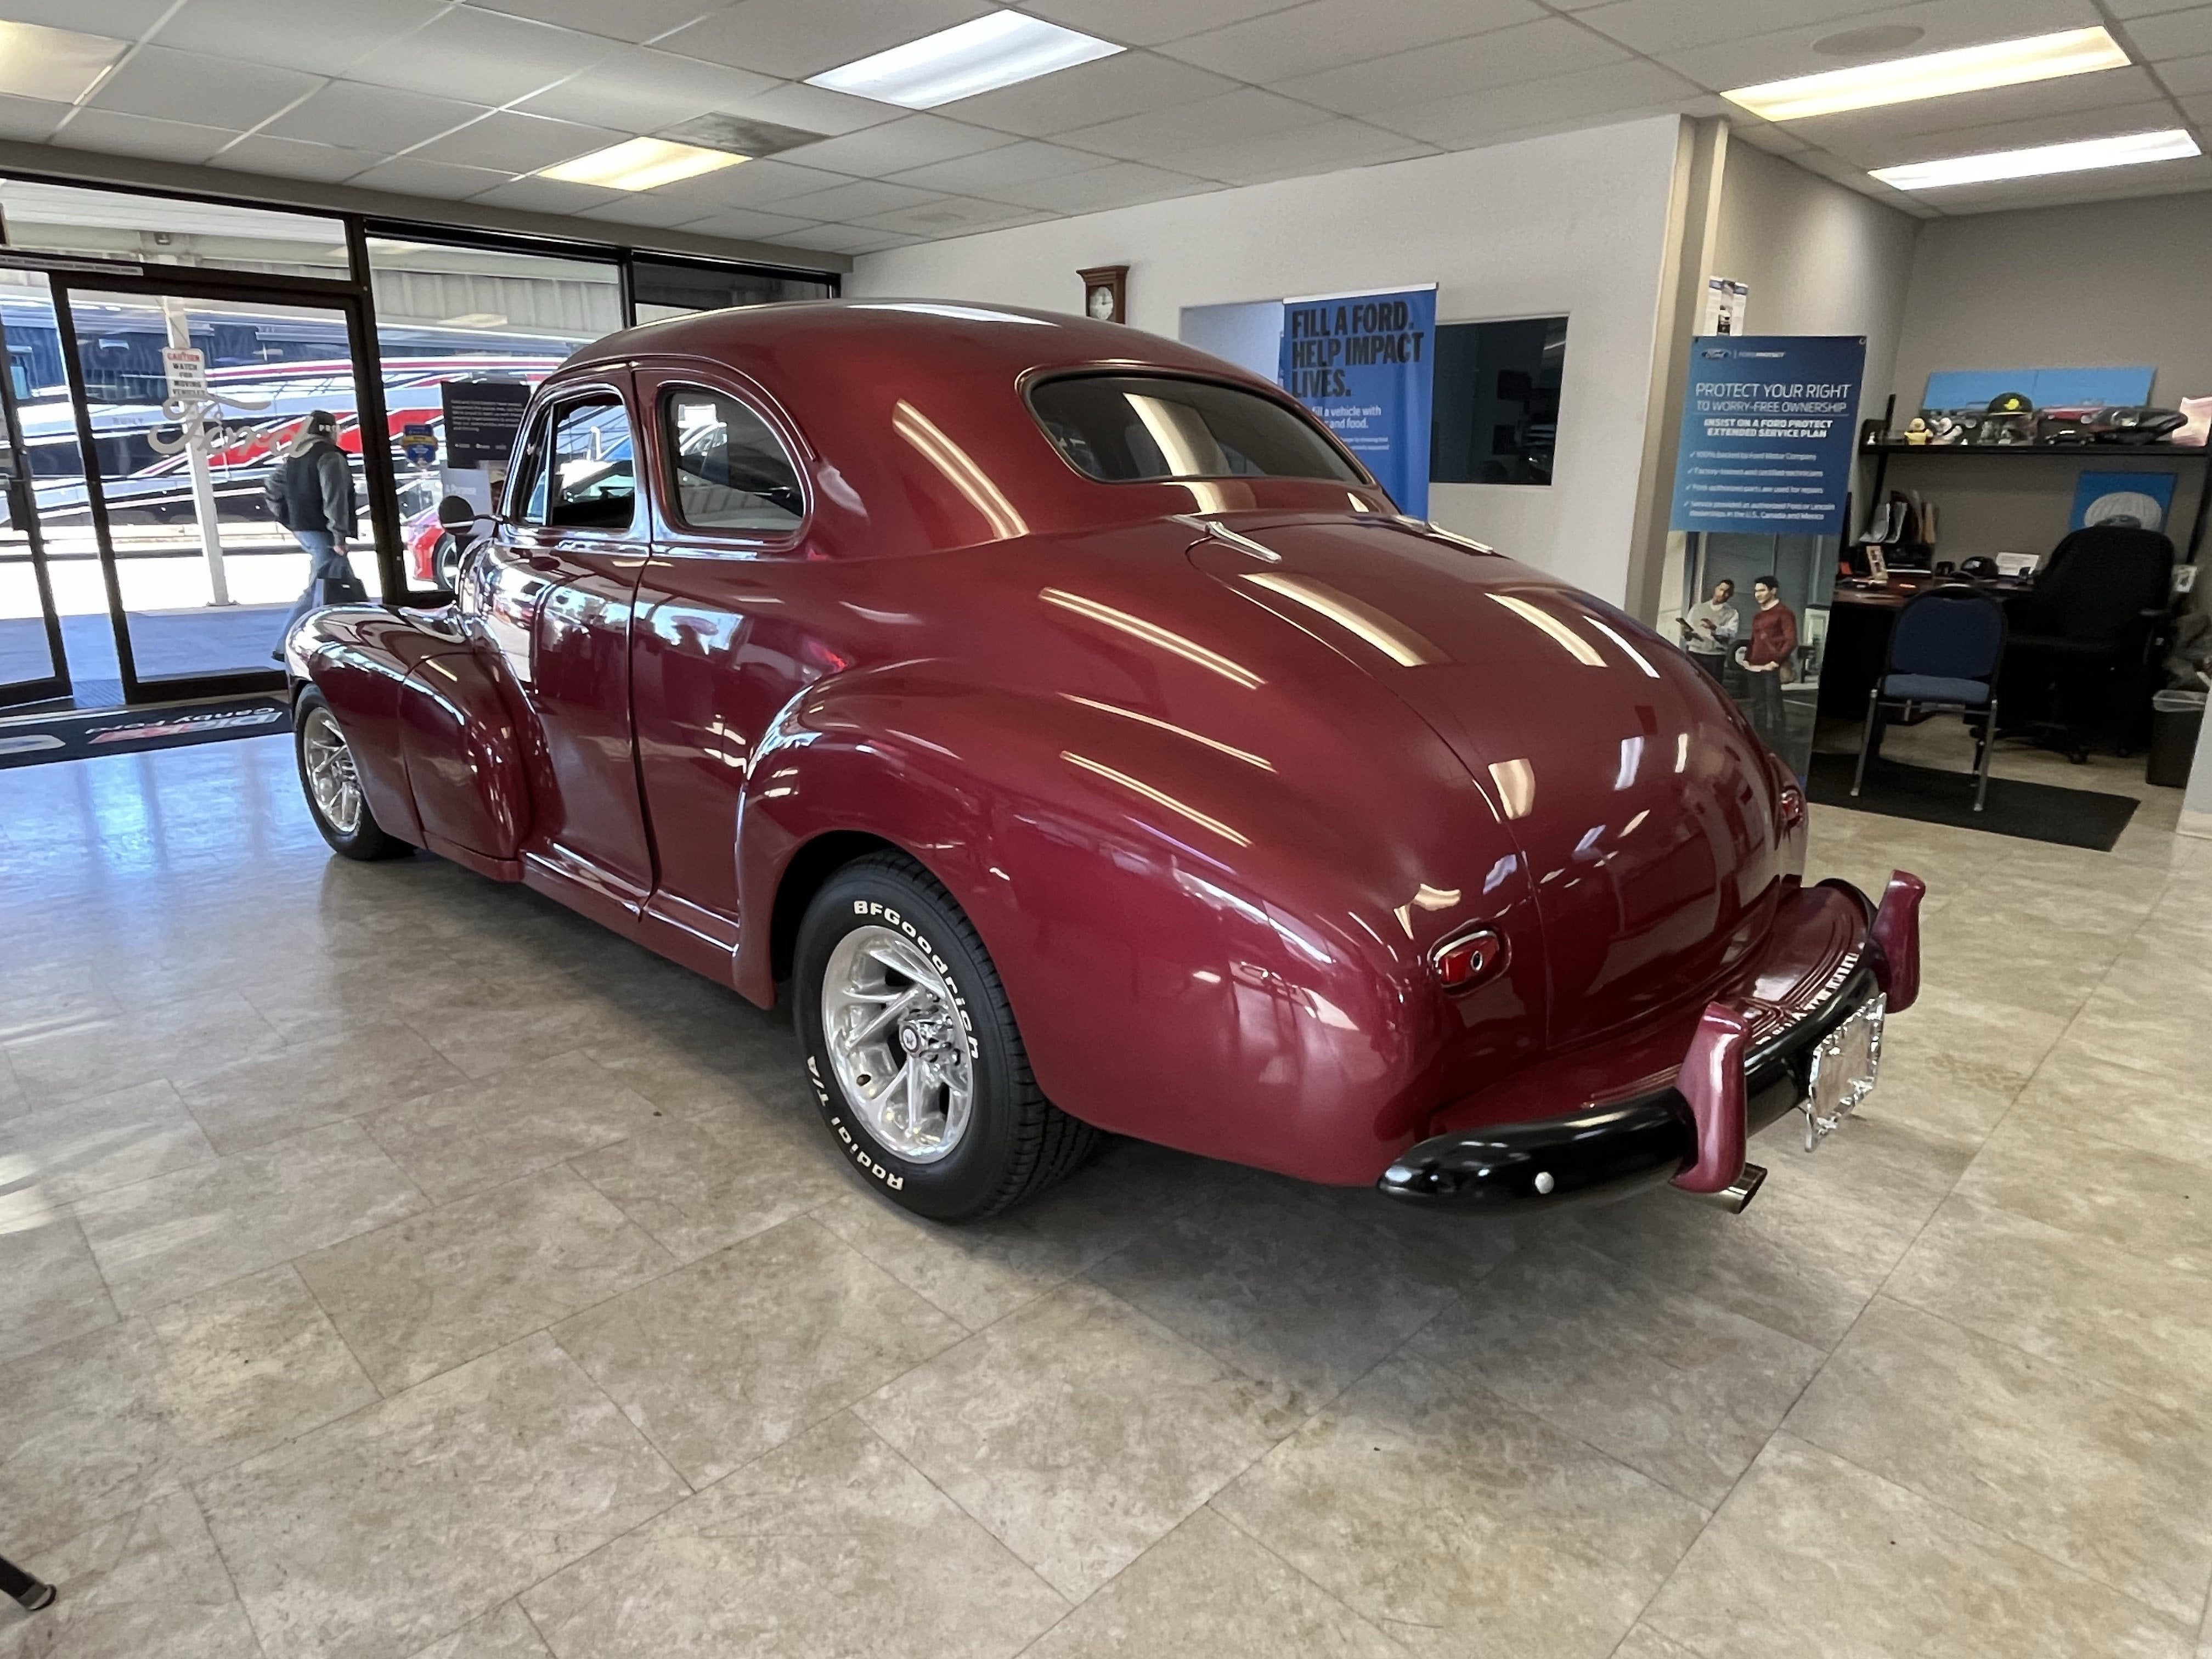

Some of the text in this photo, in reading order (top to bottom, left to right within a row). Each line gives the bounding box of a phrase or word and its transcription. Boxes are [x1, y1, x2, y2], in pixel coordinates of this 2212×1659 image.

[1292, 301, 1414, 339] FILL A FORD.
[167, 352, 200, 362] CAUTION
[1292, 331, 1424, 369] HELP IMPACT
[1292, 369, 1352, 398] LIVES.
[1695, 383, 1852, 398] PROTECT YOUR RIGHT
[1330, 405, 1361, 416] vehicle
[1362, 405, 1381, 416] with
[1697, 400, 1847, 413] TO WORRY-FREE OWNERSHIP
[148, 393, 314, 459] Ford
[1707, 428, 1827, 438] EXTENDED SERVICE PLAN
[1788, 419, 1833, 428] PROTECT
[854, 900, 979, 1059] BFGoodrich
[807, 1056, 904, 1190] Radial T/A
